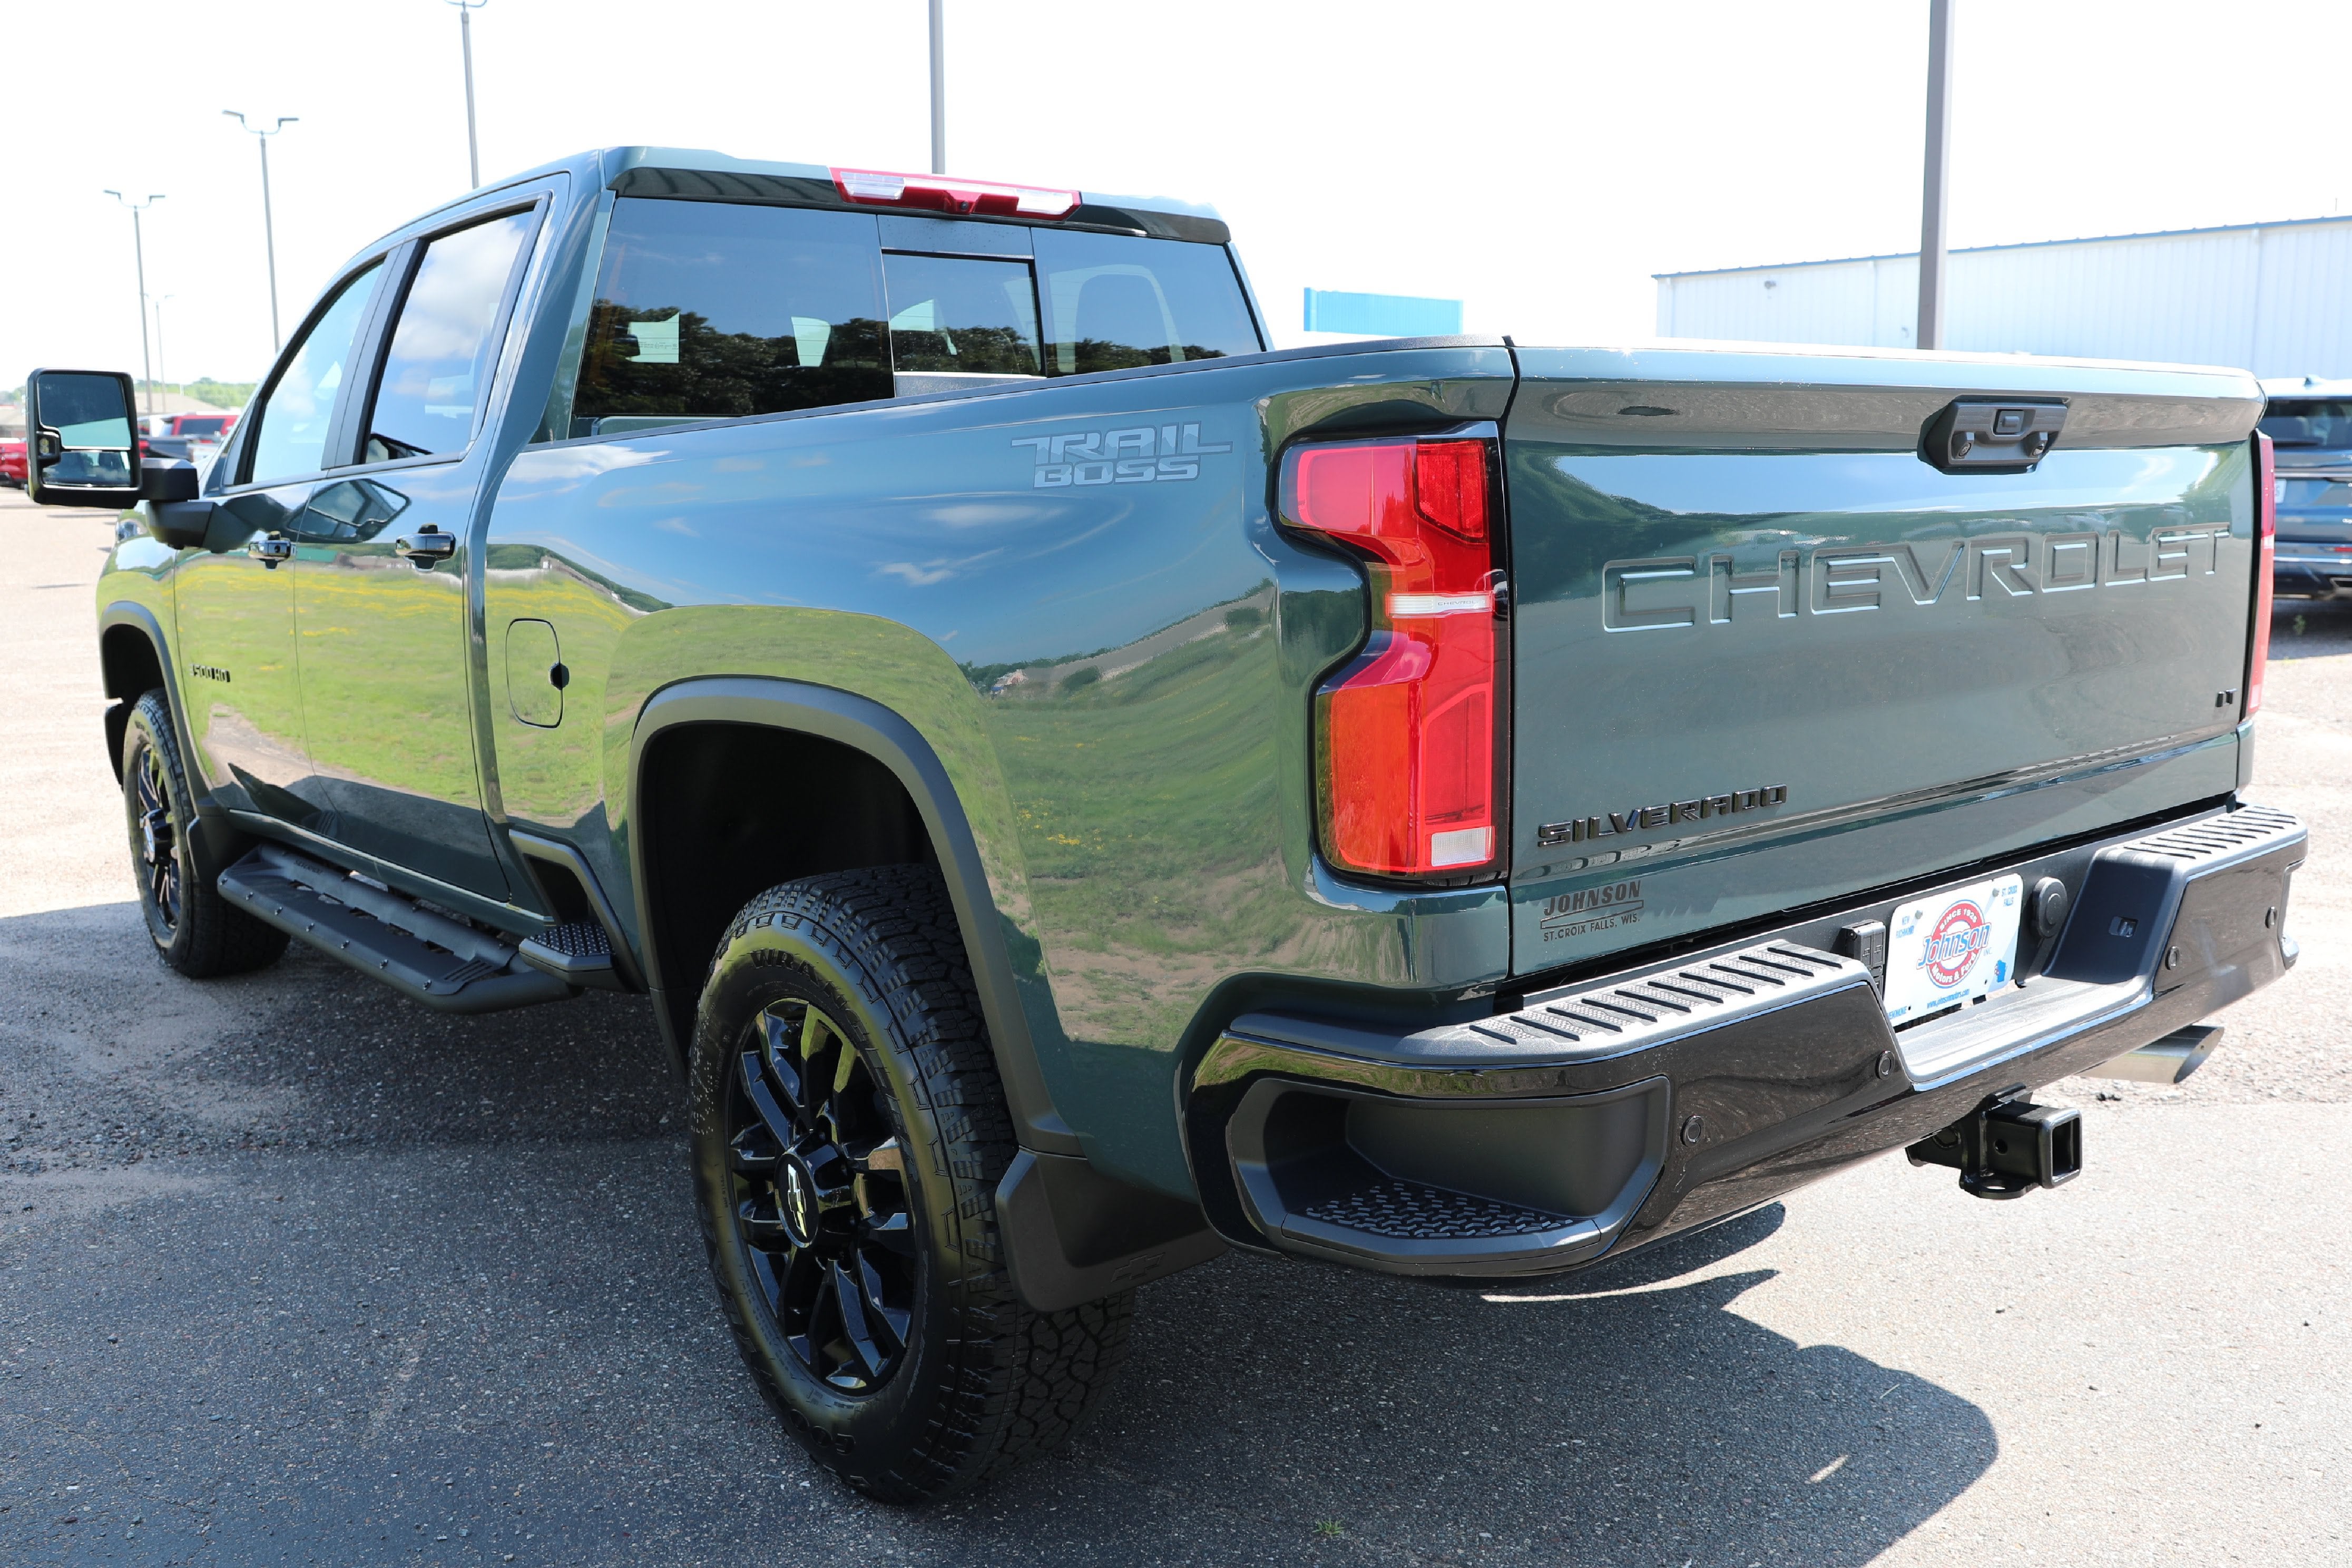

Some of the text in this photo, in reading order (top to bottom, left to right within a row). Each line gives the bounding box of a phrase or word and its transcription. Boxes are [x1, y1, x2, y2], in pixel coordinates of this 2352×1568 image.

[1011, 420, 1233, 465] TRAIL
[1033, 454, 1200, 489] BOSS
[1603, 523, 2230, 633] CHEVROLET
[1538, 783, 1787, 847] SILVERADO
[1544, 880, 1641, 916] JOHNSON
[1621, 912, 1640, 925] WIS.
[1939, 908, 1962, 931] SINCE
[1917, 923, 1991, 968] Johnson
[1932, 952, 1977, 983] Motors & Ford
